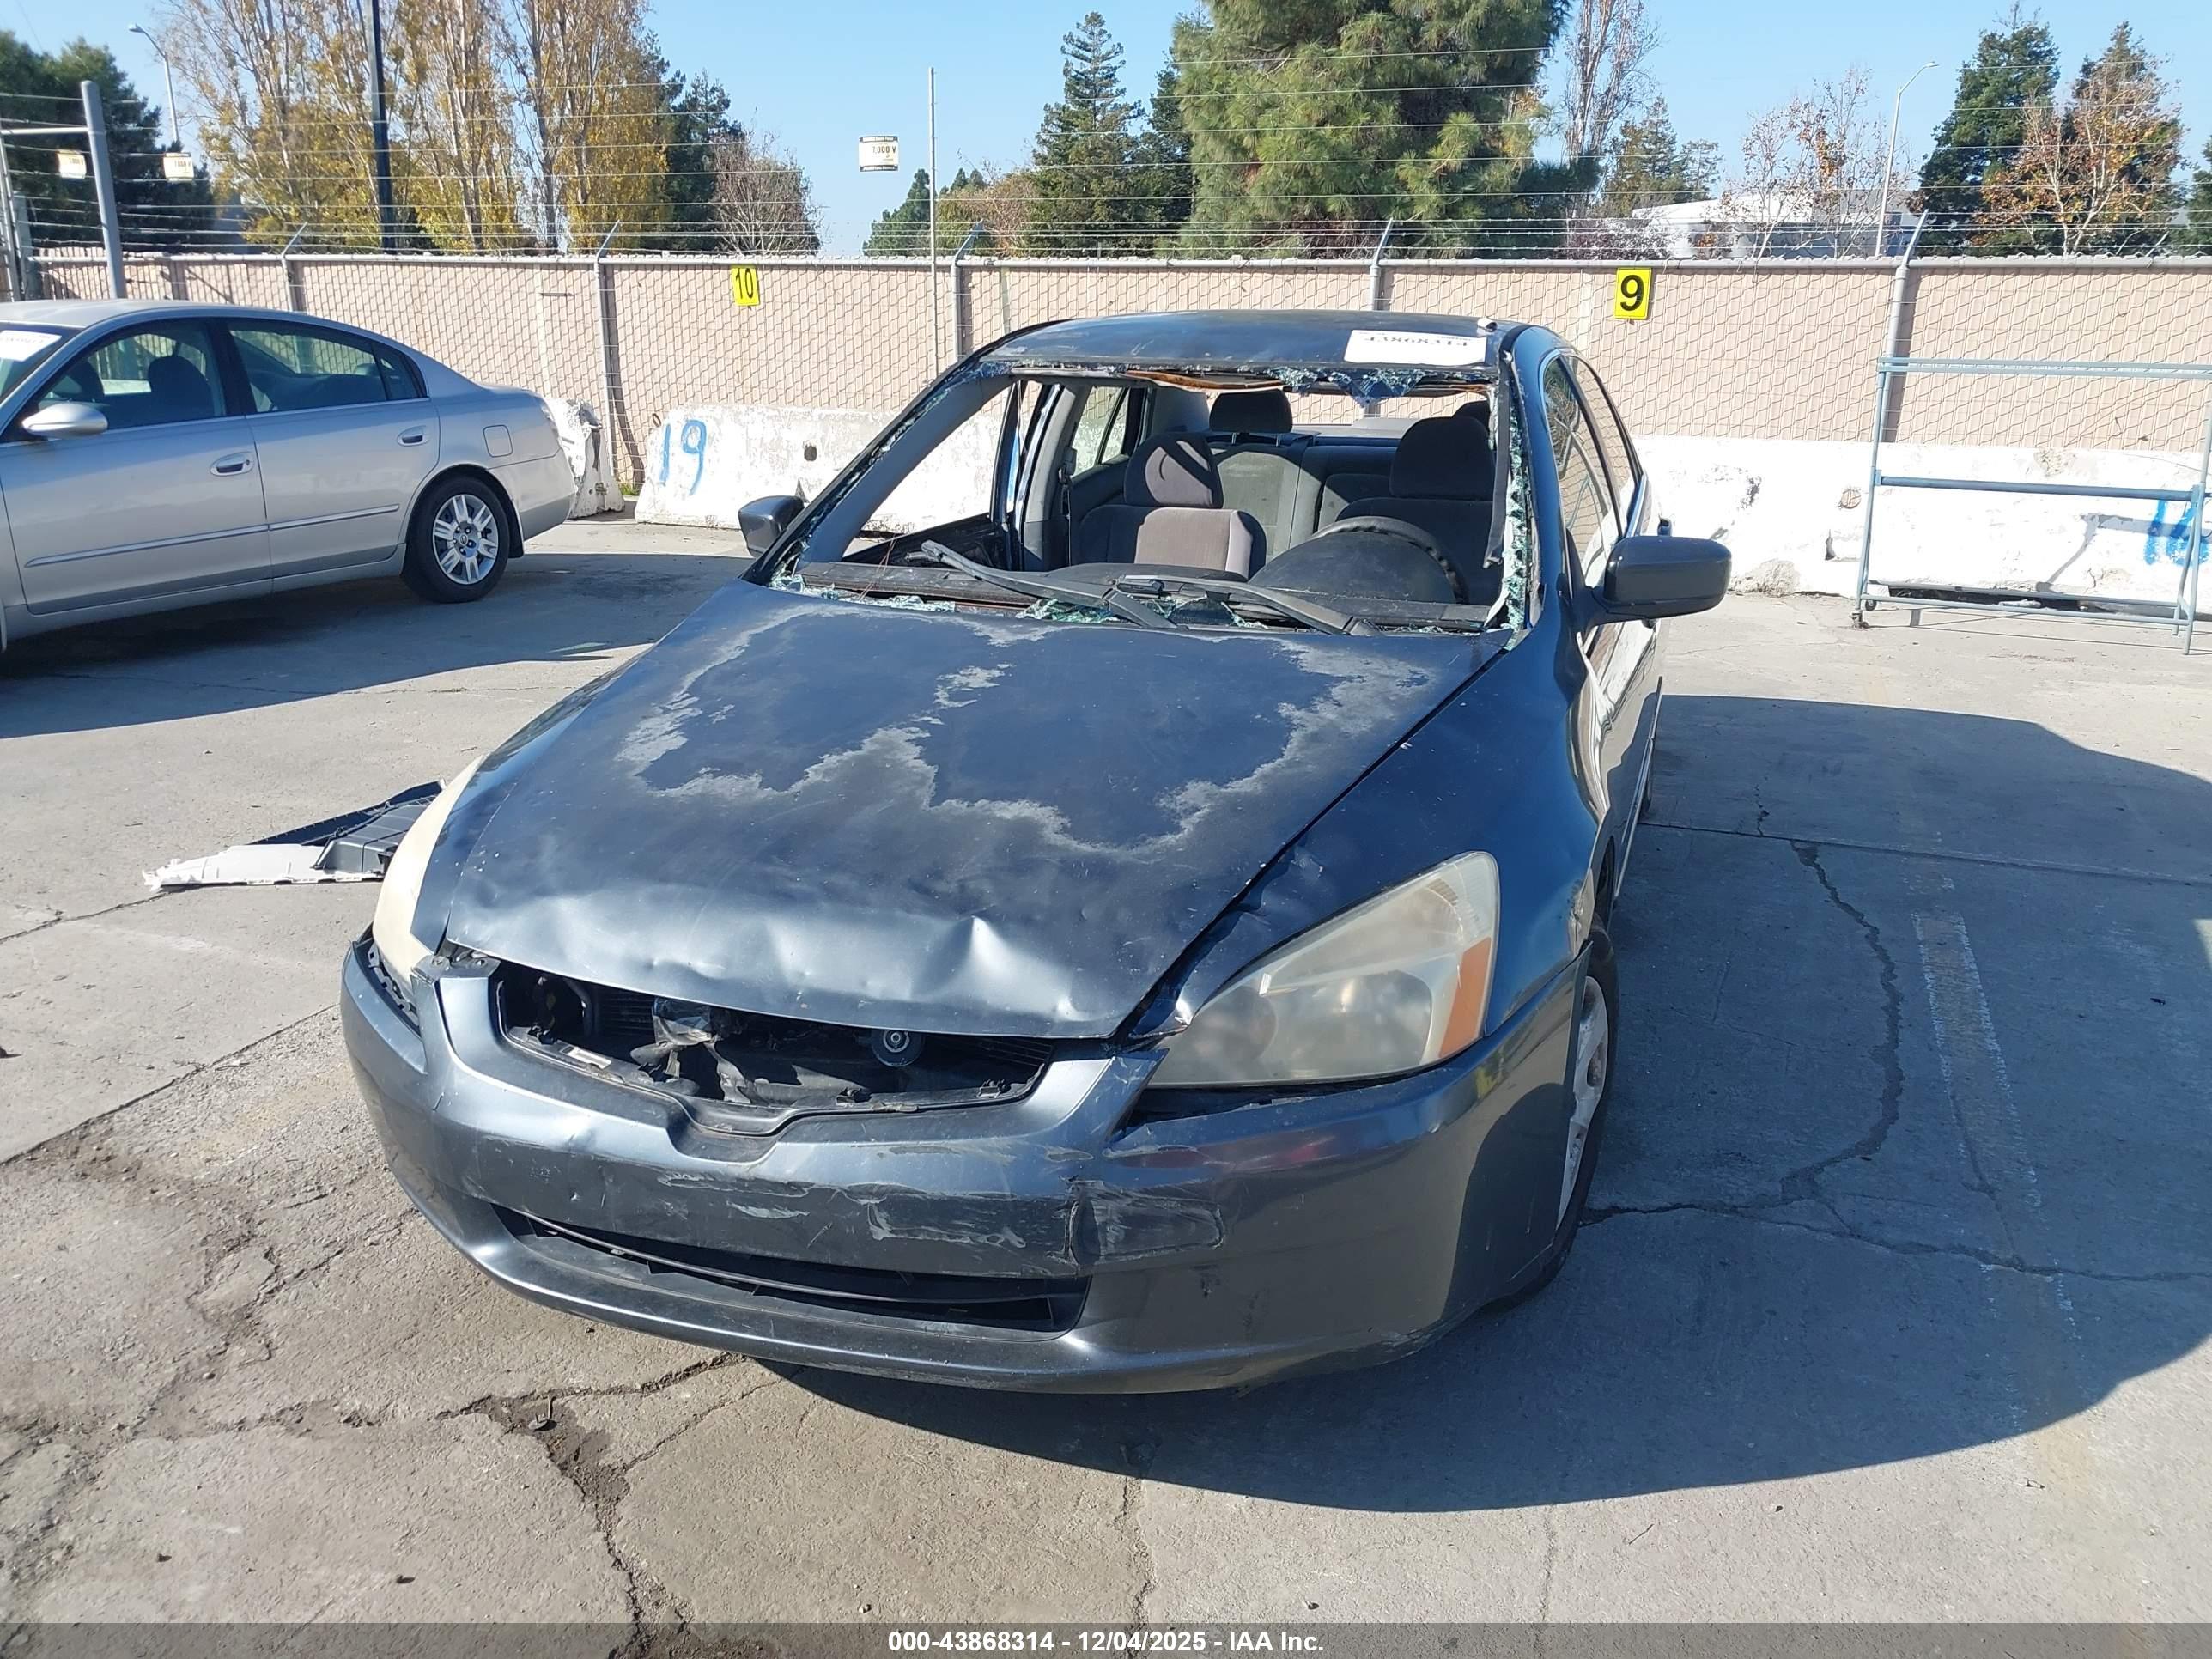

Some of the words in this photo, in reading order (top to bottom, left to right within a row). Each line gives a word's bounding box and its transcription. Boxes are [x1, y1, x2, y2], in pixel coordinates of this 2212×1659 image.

[735, 267, 754, 300] 10
[1620, 274, 1644, 312] 9
[659, 419, 707, 495] 19
